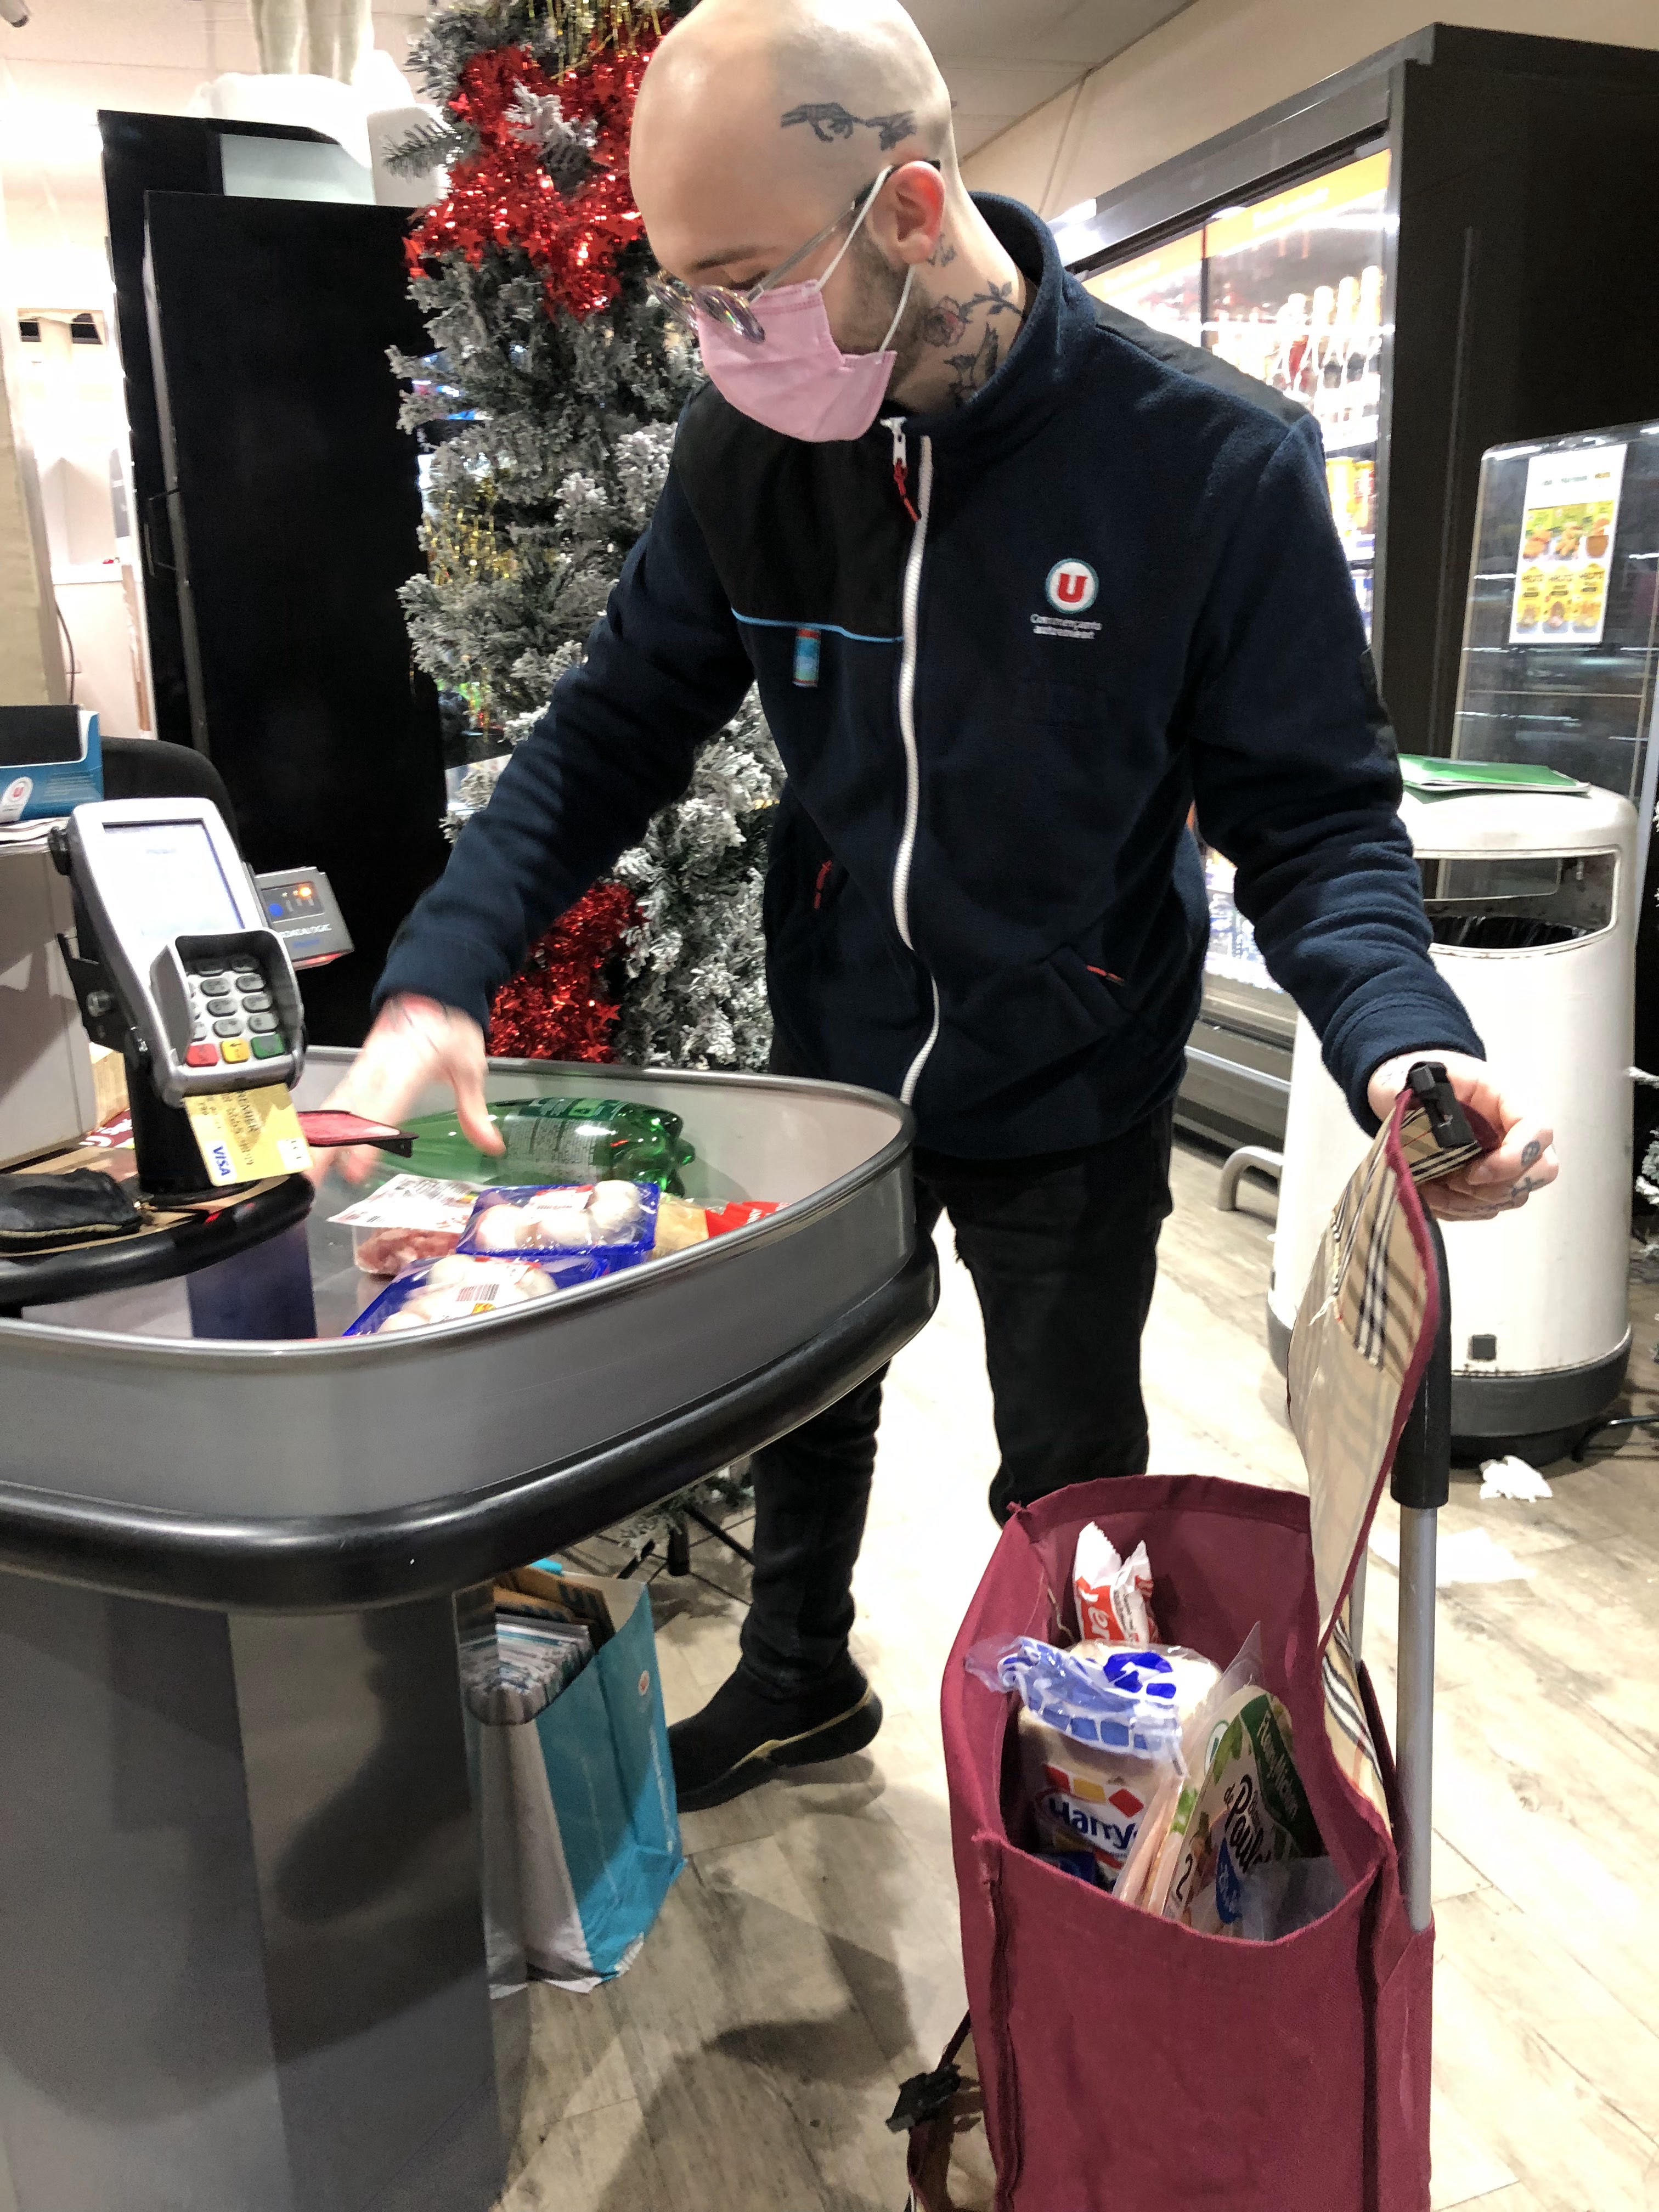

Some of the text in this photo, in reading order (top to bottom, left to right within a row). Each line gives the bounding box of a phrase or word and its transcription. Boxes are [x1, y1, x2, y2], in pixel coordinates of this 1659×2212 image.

[1058, 573, 1088, 603] U
[213, 1146, 231, 1177] VISA
[1049, 1798, 1138, 1850] Harry
[1225, 1775, 1272, 1874] Poul
